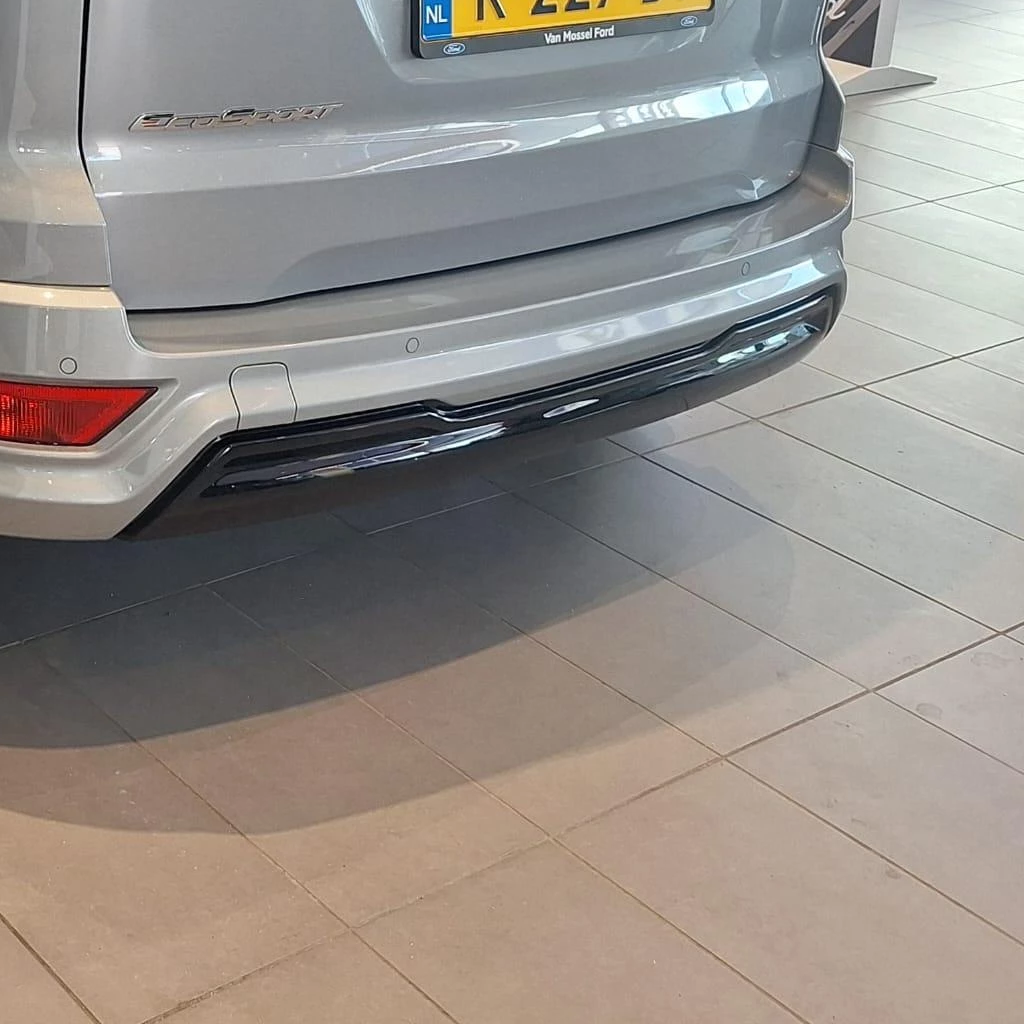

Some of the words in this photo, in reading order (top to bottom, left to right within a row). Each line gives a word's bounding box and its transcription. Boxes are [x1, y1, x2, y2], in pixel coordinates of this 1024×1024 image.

[426, 5, 448, 25] NL
[544, 32, 561, 44] Van
[563, 29, 592, 42] Mossel
[594, 25, 614, 38] Ford
